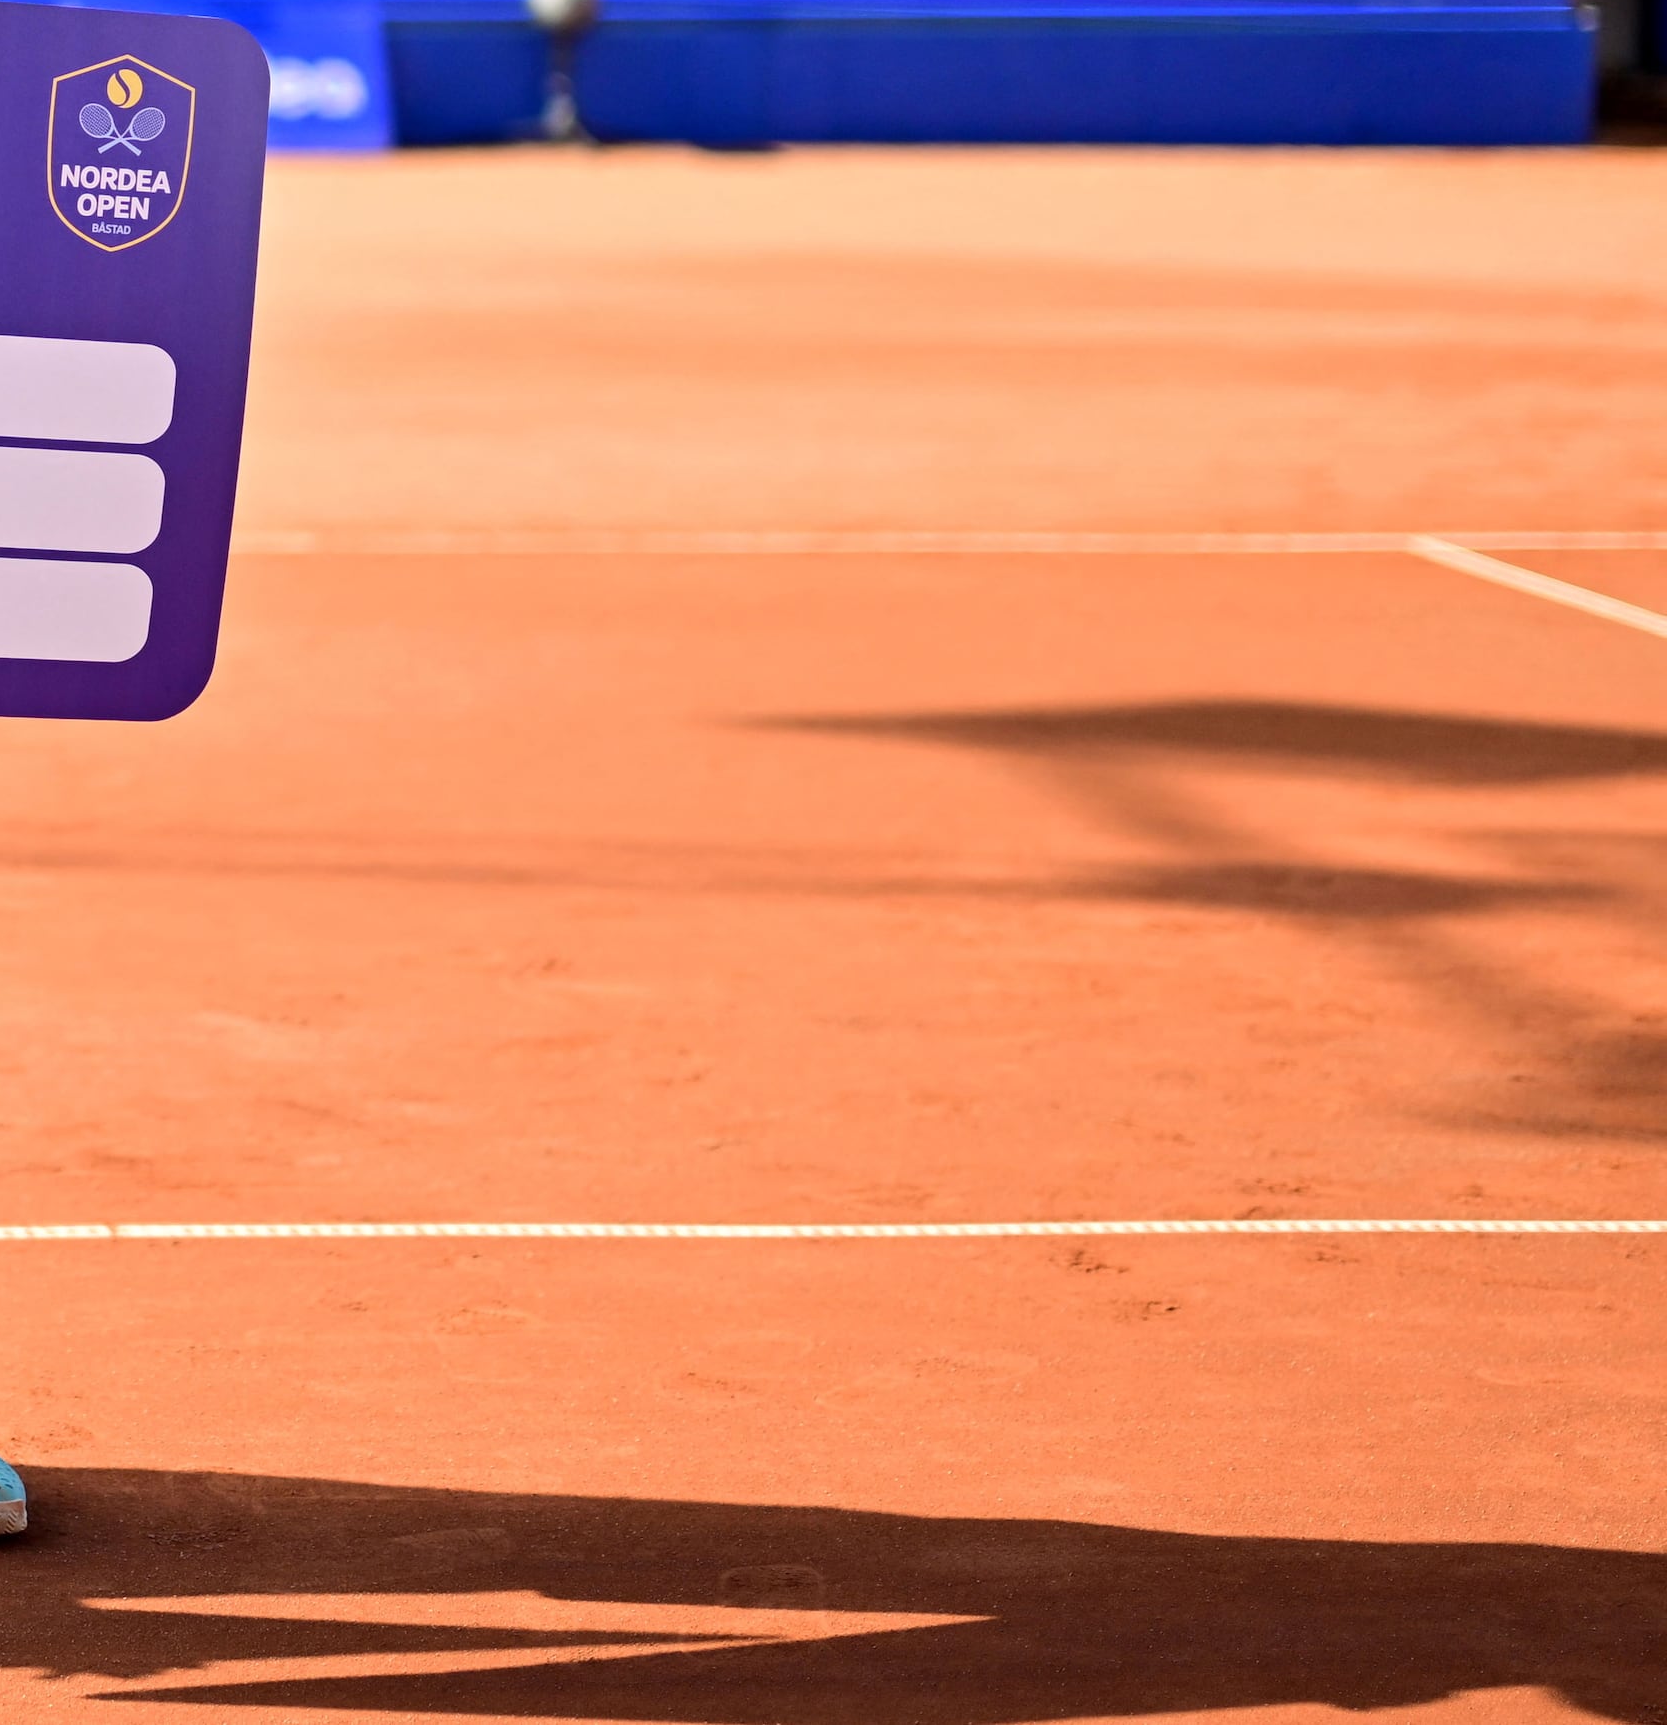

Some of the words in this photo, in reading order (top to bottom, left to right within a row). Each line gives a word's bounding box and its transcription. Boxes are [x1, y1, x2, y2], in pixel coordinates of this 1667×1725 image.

[60, 164, 171, 195] NORDEA
[76, 193, 150, 221] OPEN
[91, 221, 132, 235] BÅSTAD
